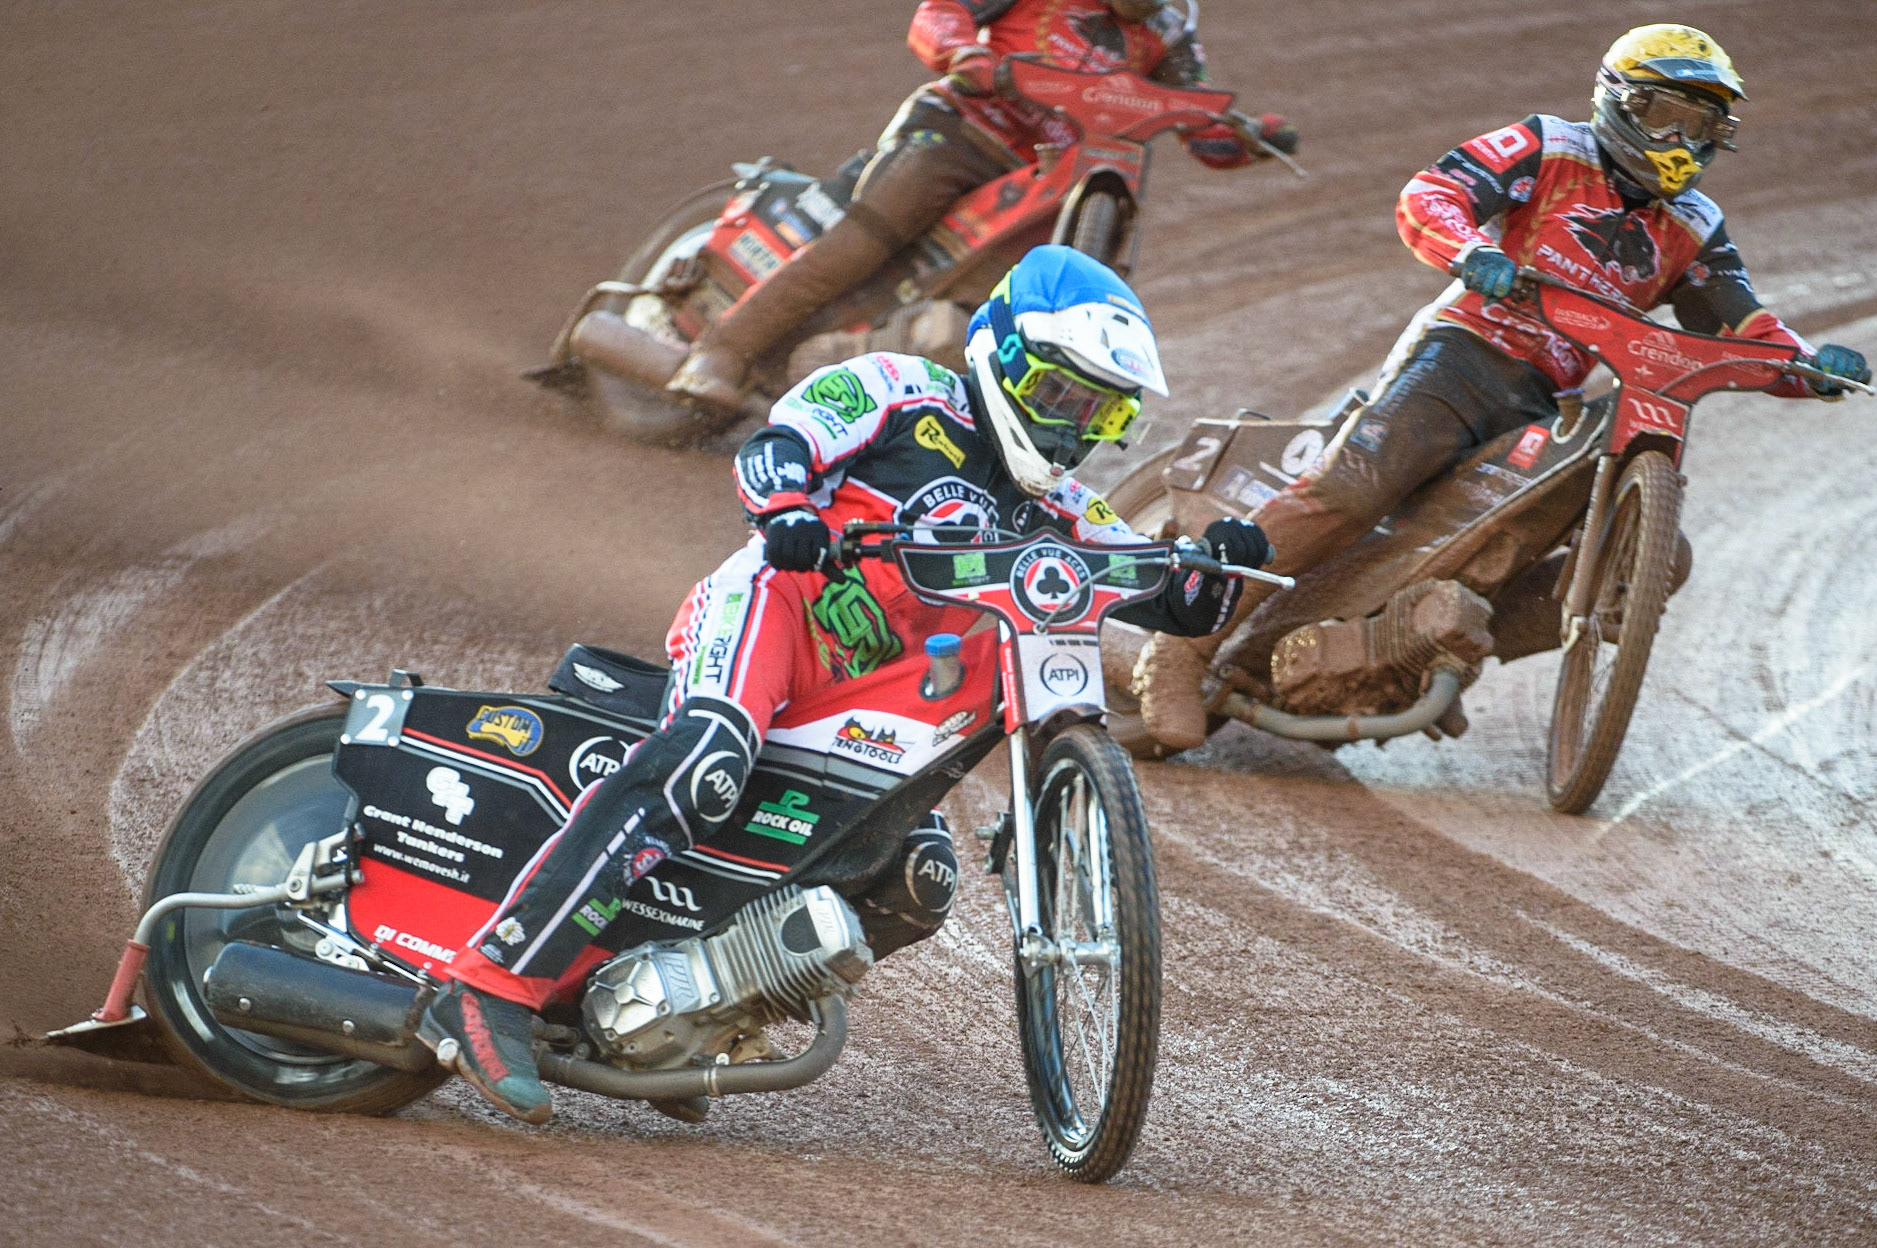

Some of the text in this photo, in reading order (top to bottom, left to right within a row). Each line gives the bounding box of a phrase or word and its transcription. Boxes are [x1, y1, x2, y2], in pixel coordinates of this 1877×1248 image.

[1627, 340, 1703, 371] Crendon
[1173, 437, 1221, 471] 2
[923, 484, 965, 508] BELLE
[1016, 548, 1086, 578] BELLE VUE ACES
[1049, 668, 1080, 681] ATPI
[355, 694, 395, 742] 2
[579, 752, 621, 777] ATP
[363, 805, 504, 859] Grant Henderson
[751, 810, 814, 837] ROCK OIL
[396, 831, 465, 863] Tankers
[621, 899, 705, 931] WESSEXMARINE
